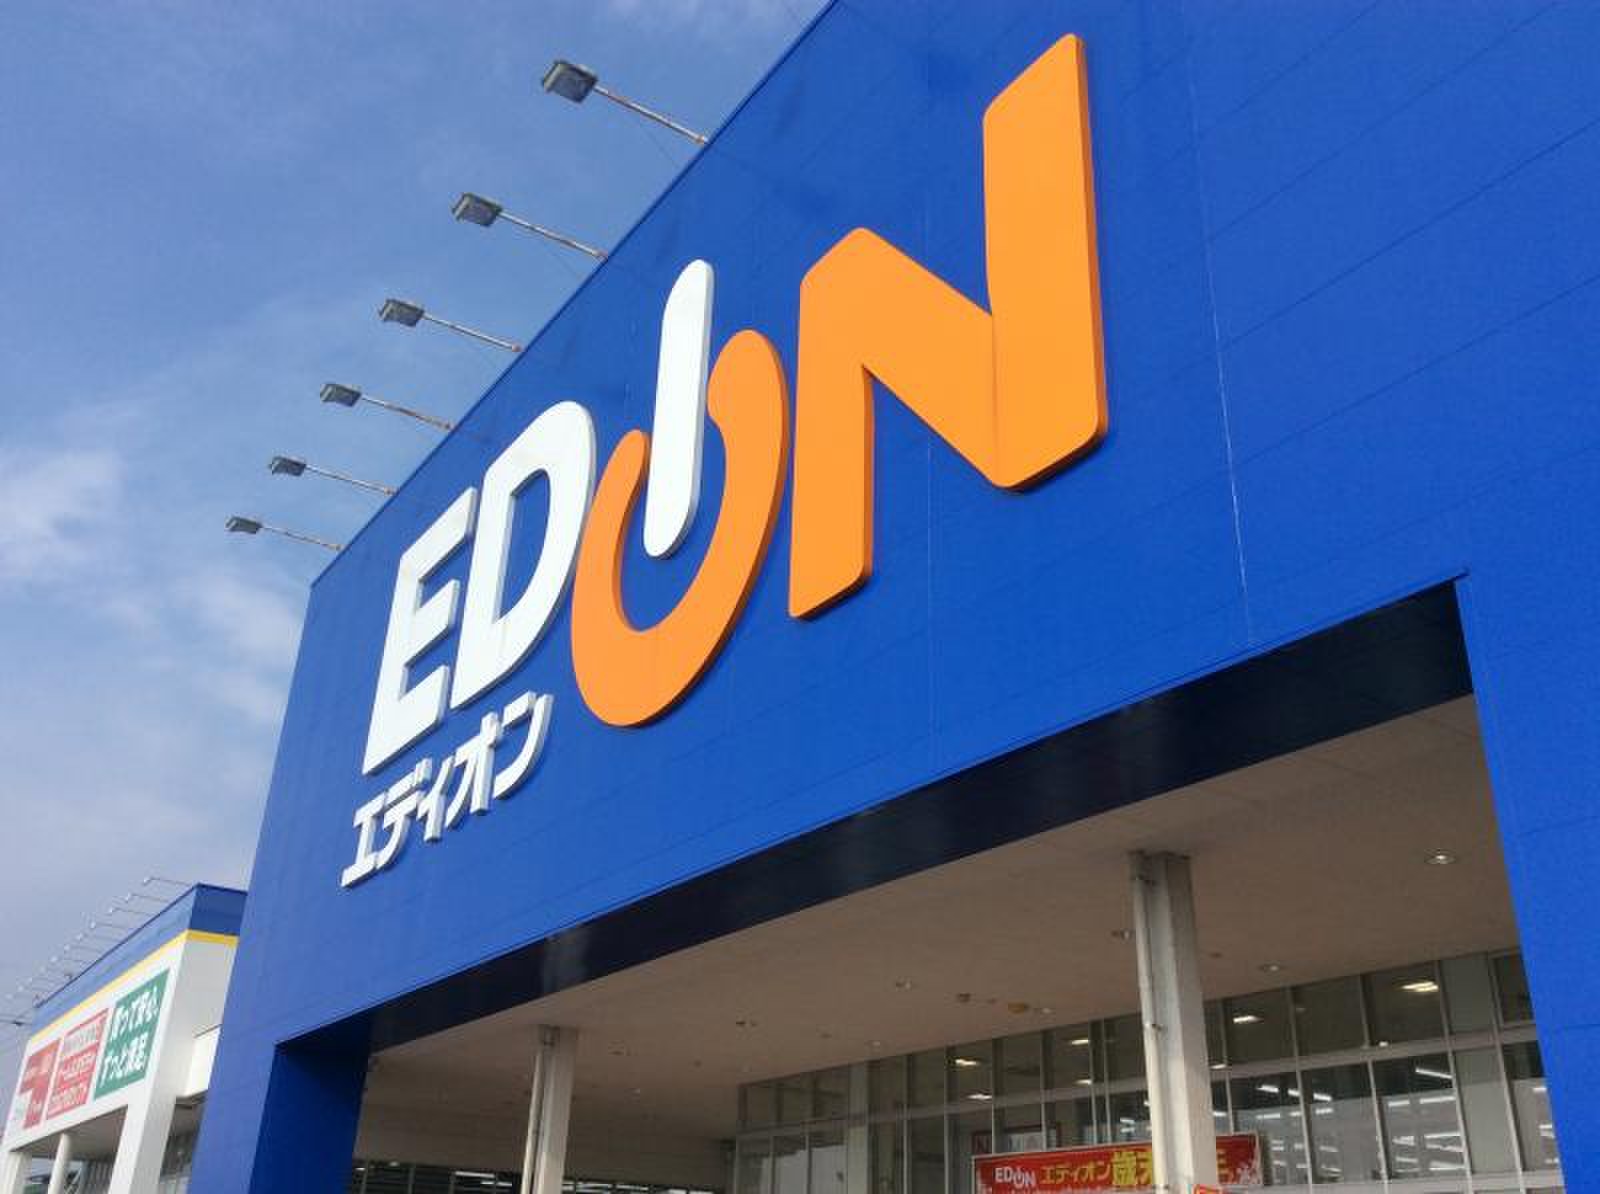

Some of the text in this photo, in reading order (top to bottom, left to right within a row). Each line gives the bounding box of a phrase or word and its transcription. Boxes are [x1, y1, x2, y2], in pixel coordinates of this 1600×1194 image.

[362, 33, 1108, 776] EDION
[341, 690, 554, 888] エディオン
[994, 1166, 1036, 1188] EDION
